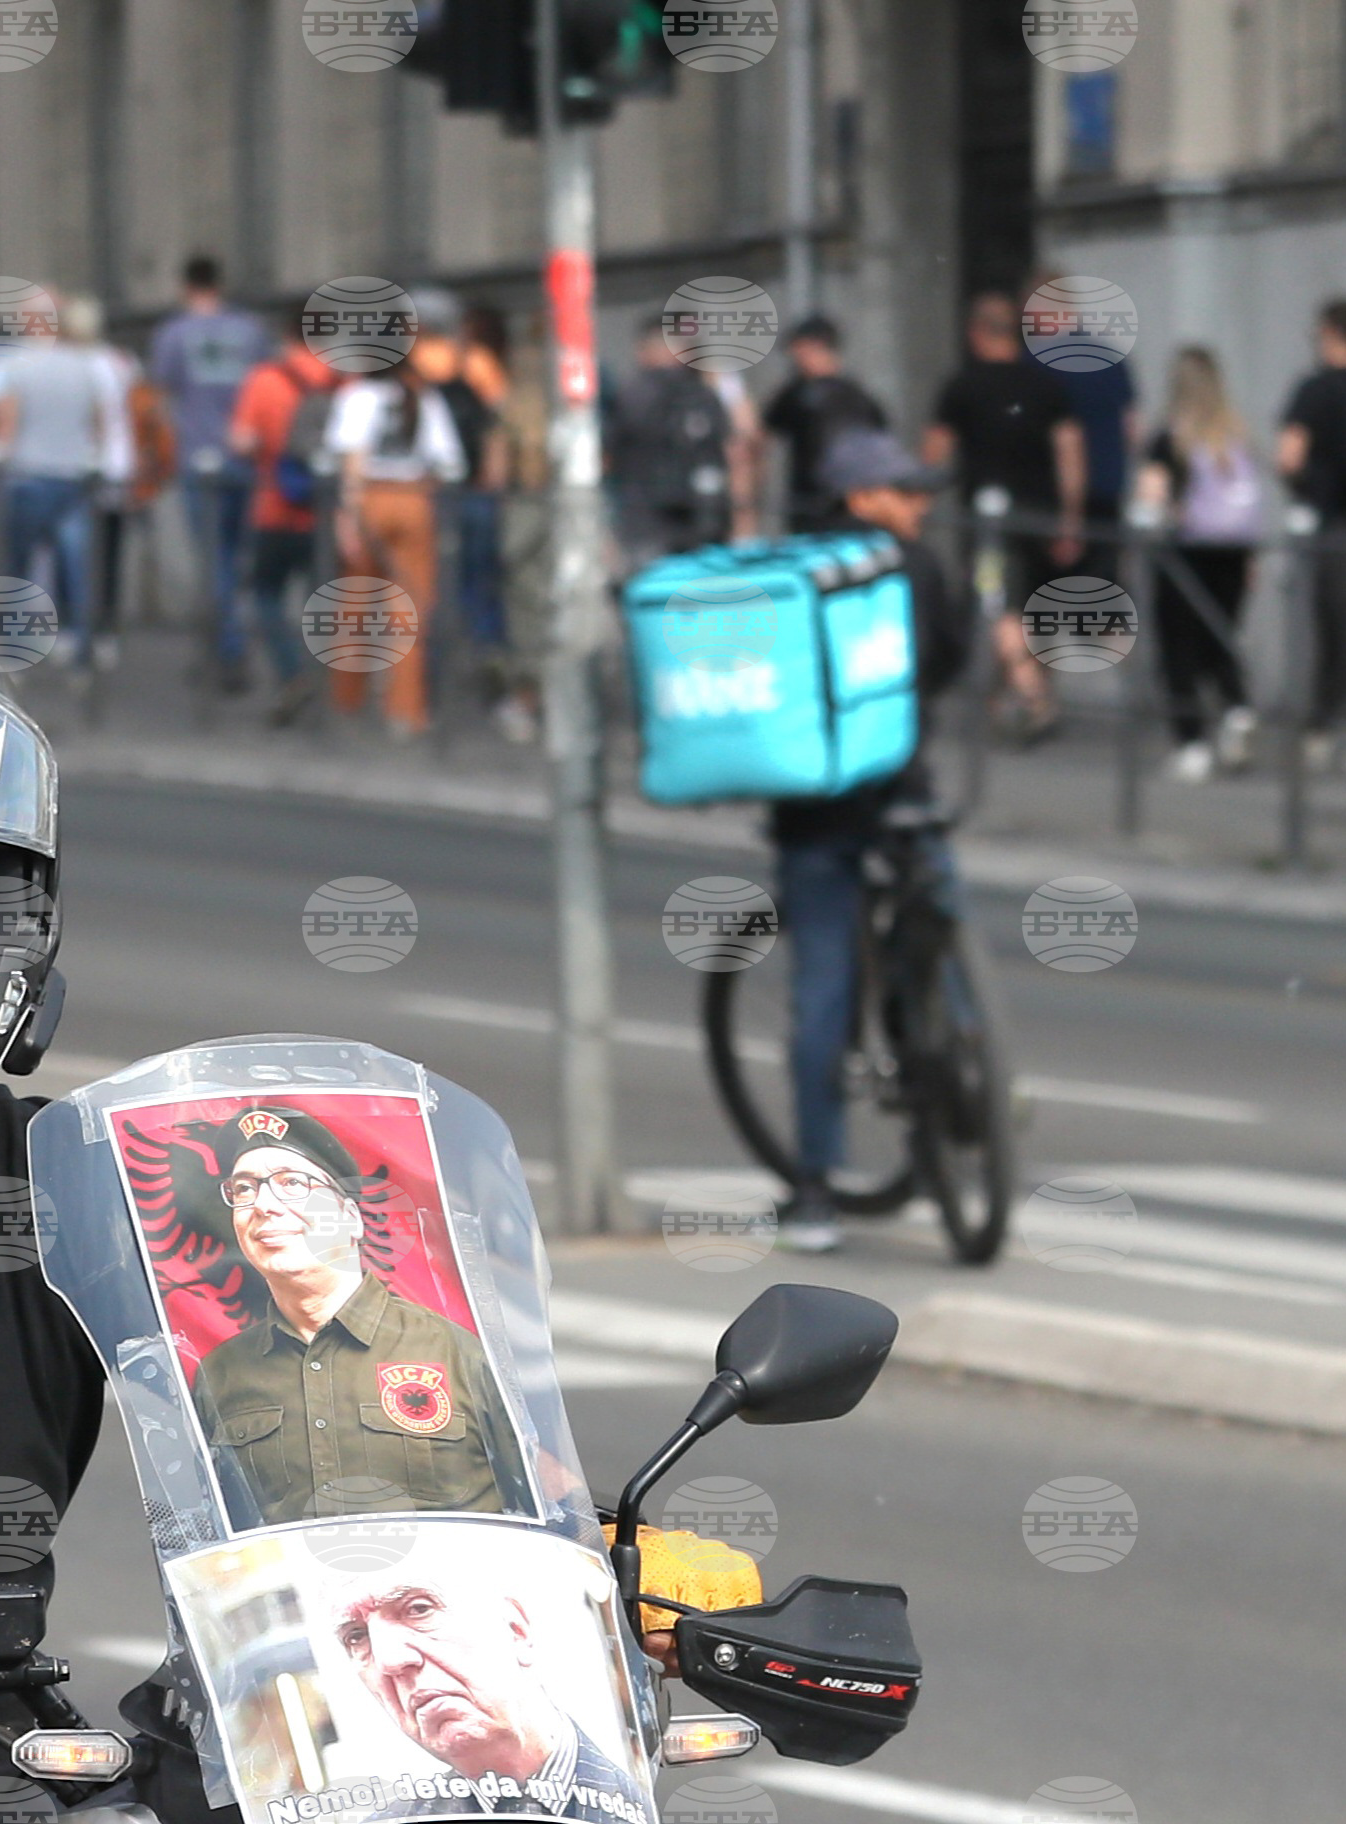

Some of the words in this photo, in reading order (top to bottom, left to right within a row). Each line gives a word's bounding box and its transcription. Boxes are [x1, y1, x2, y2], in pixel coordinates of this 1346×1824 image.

[243, 1115, 282, 1135] UCK
[386, 1367, 438, 1386] UCK
[394, 1773, 470, 1802] dete
[479, 1771, 522, 1799] da
[526, 1774, 568, 1803] mi
